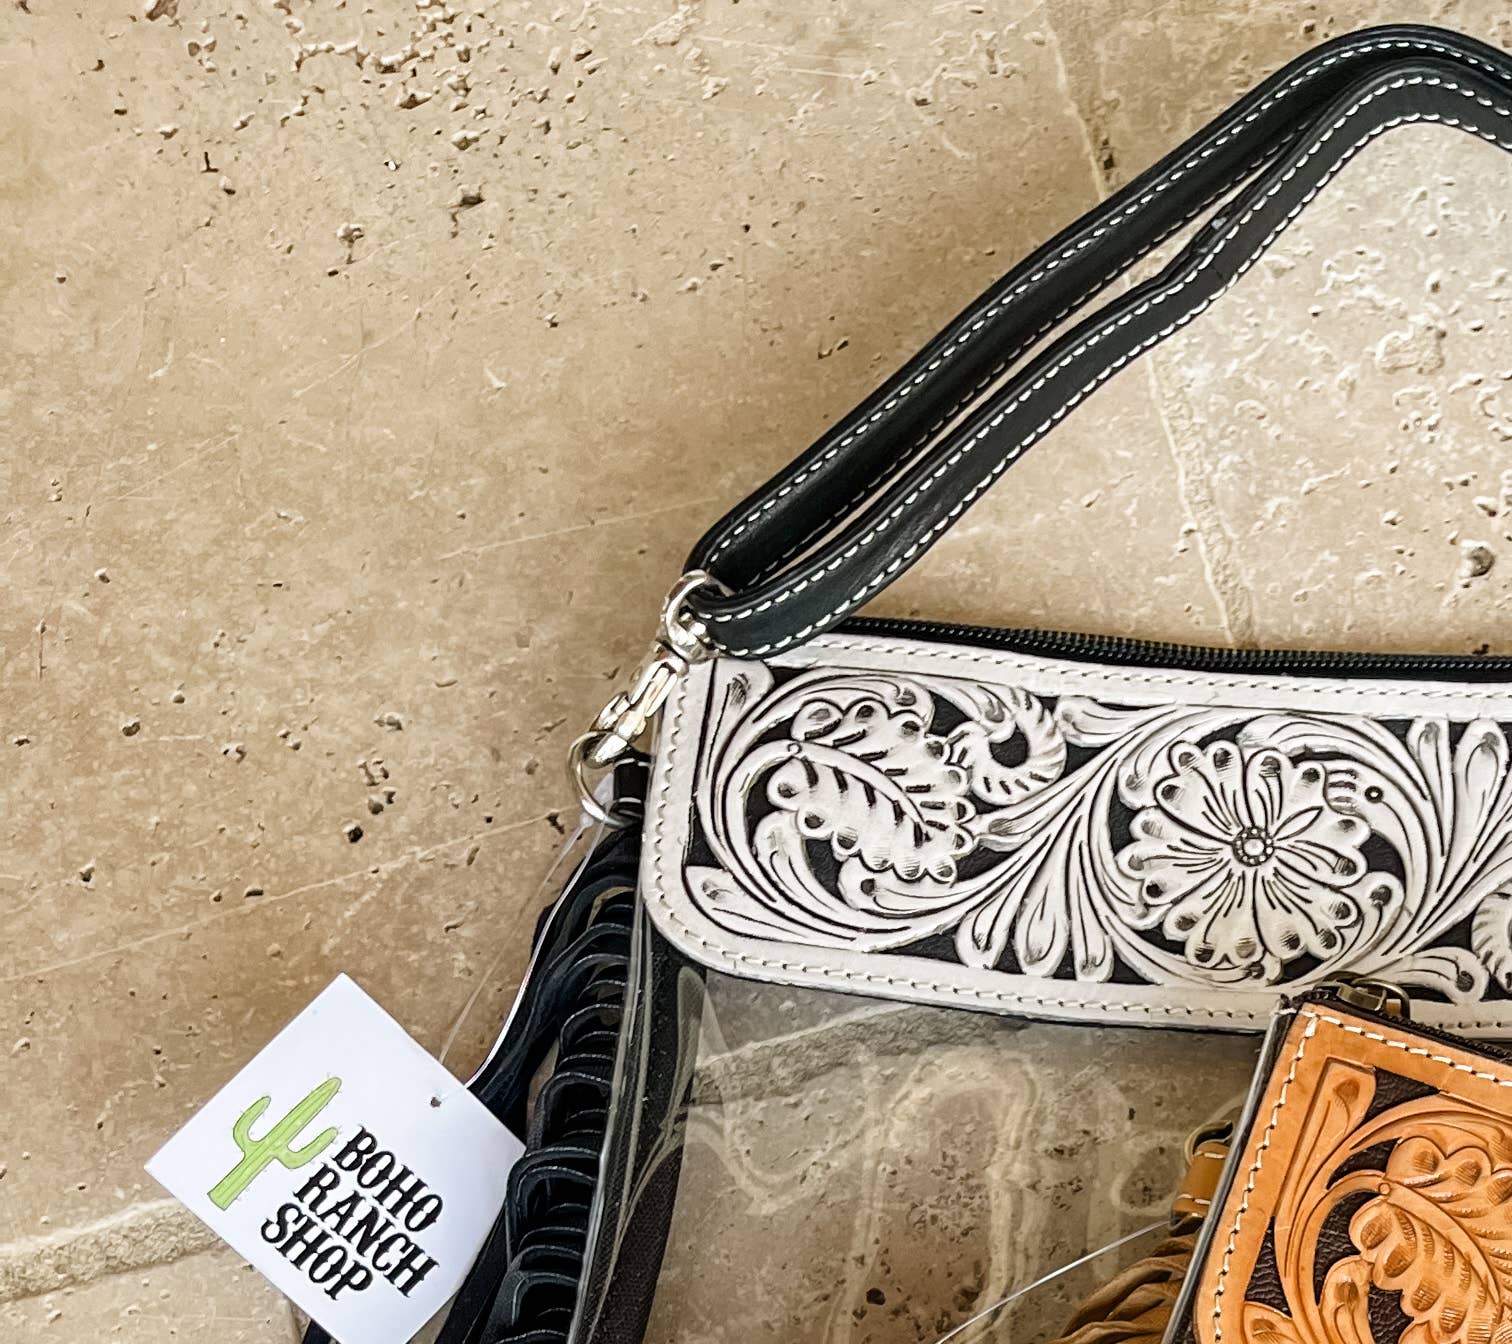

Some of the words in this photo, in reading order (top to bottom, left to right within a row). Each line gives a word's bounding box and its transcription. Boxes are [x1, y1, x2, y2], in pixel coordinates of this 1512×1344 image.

[293, 1162, 440, 1298] RANCH
[332, 1125, 442, 1232] BOHO
[260, 1202, 374, 1301] SHOP
